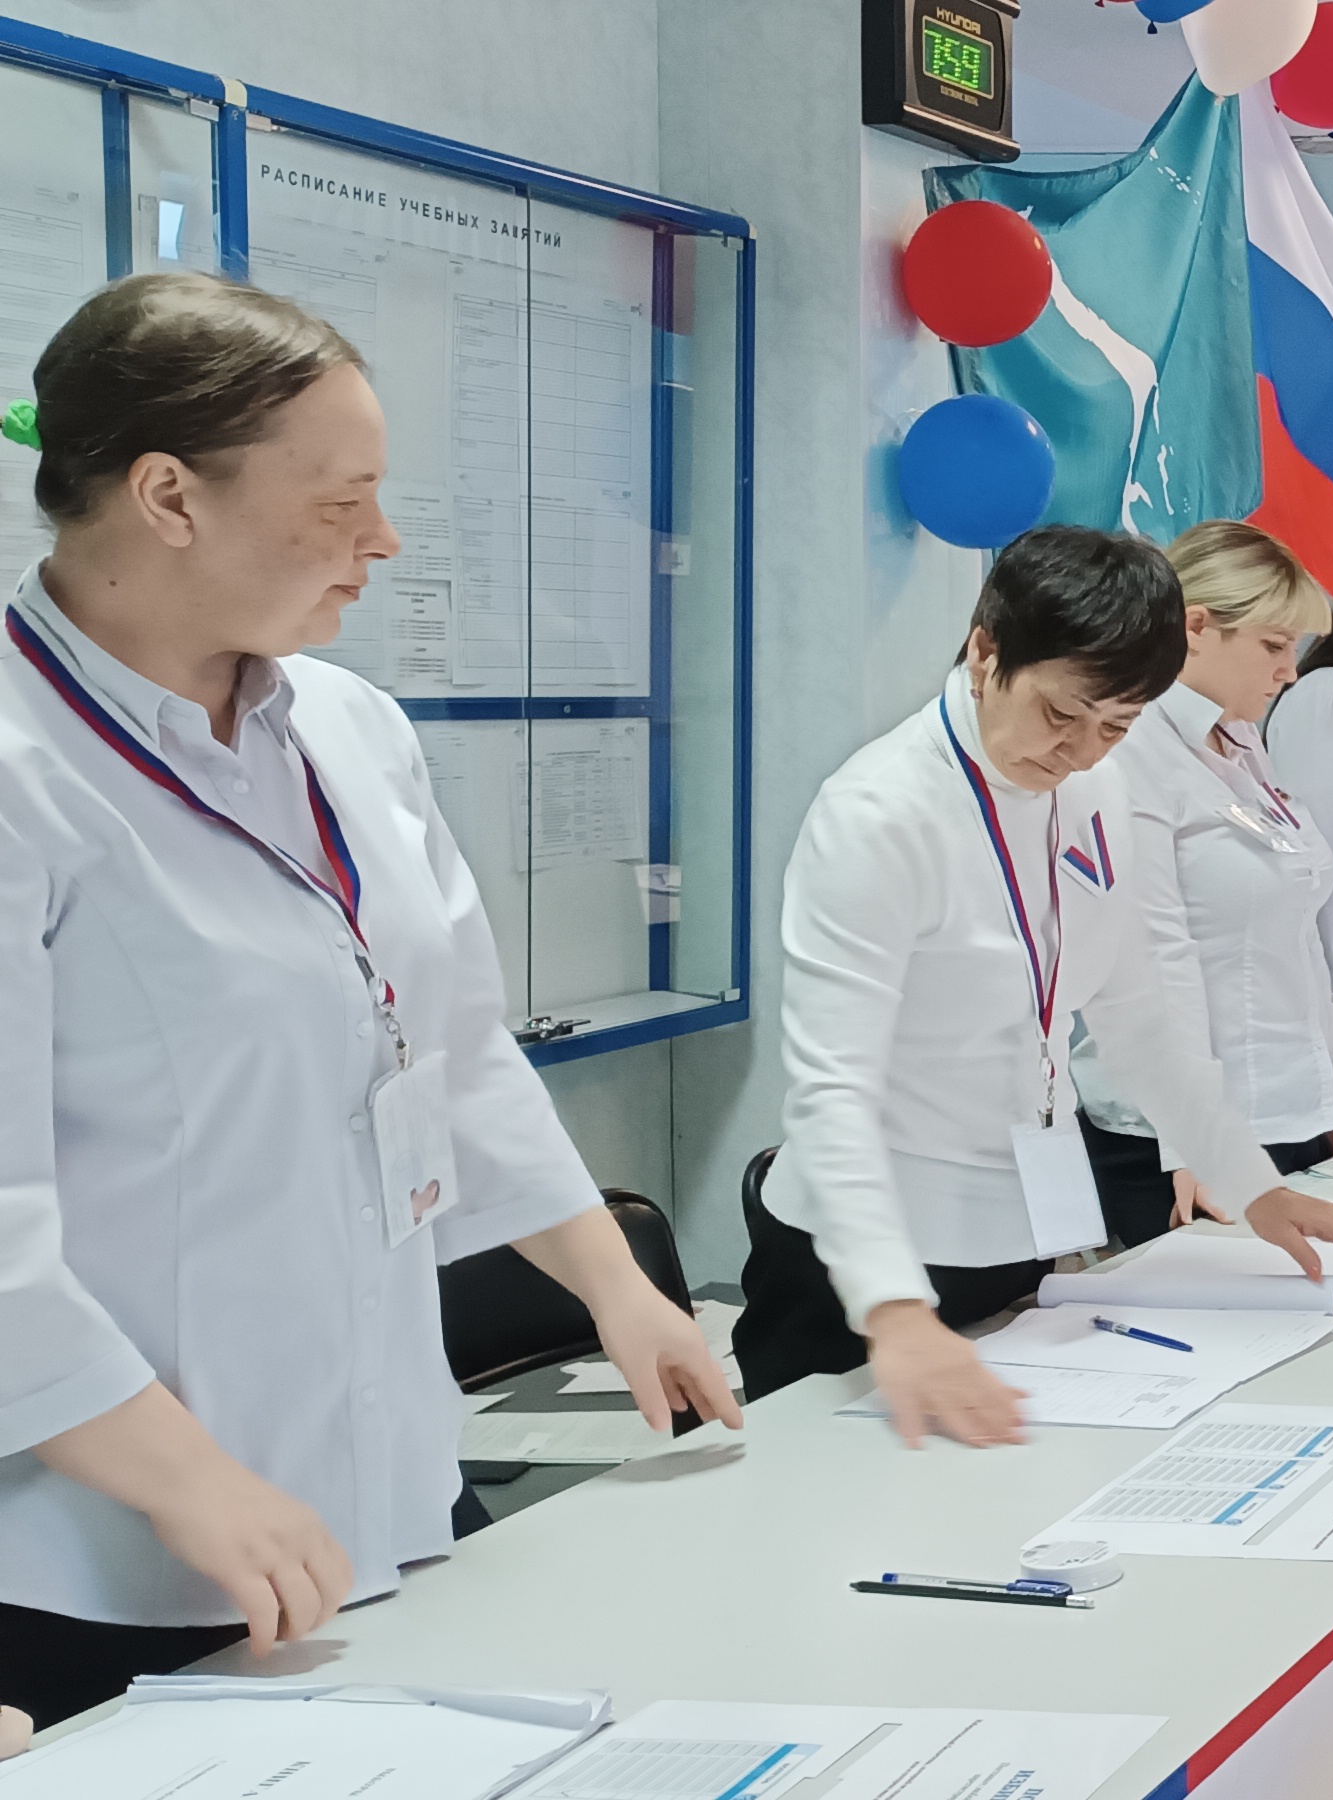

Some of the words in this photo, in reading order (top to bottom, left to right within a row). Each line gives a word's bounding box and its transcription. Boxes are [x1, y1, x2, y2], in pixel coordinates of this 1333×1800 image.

[937, 6, 981, 35] HYUNDAI
[261, 164, 386, 207] РАСПИСАНИЕ
[400, 197, 479, 229] УЧЕБНЫХ
